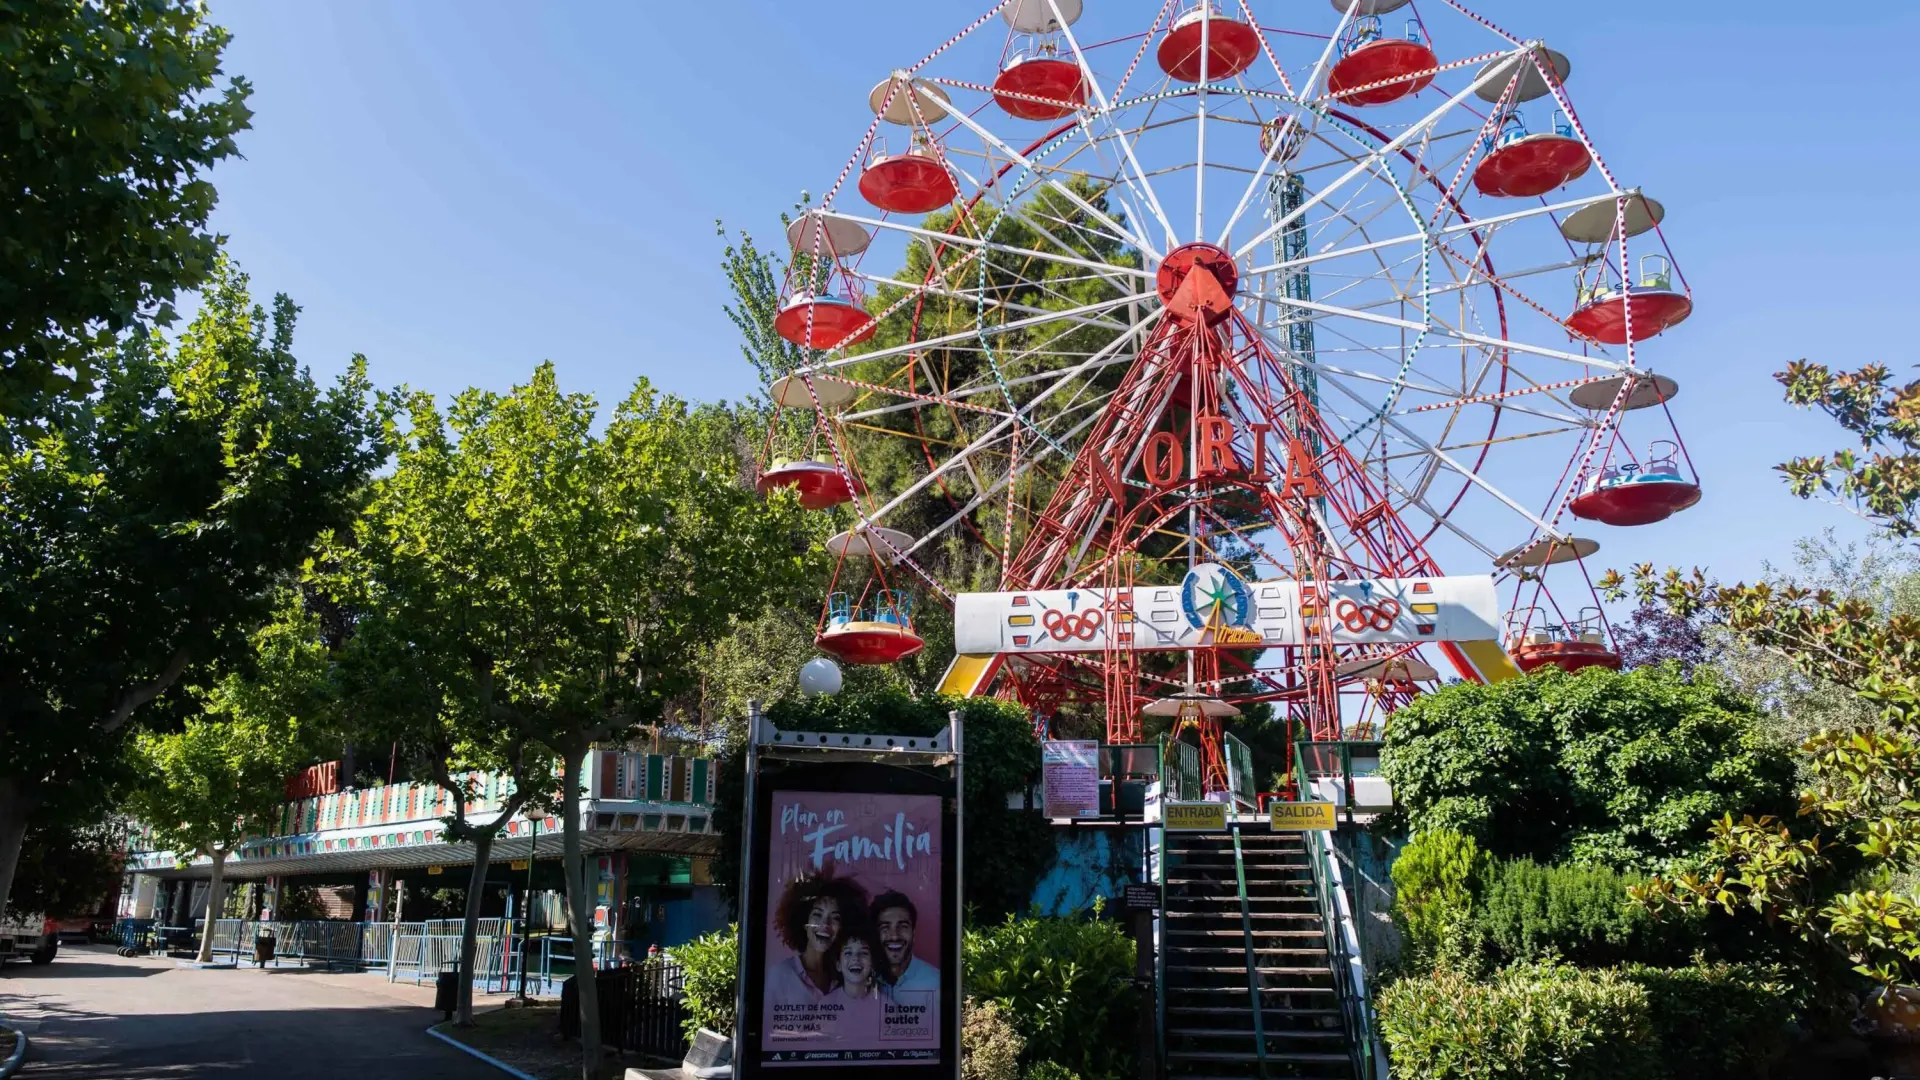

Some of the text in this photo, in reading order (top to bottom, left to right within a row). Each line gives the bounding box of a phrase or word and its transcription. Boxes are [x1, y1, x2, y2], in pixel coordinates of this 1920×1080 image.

[1086, 416, 1322, 506] NORIA
[1199, 598, 1263, 644] Atracciones
[1167, 806, 1220, 818] ENTRADA
[1275, 806, 1324, 818] SALIDA
[781, 803, 845, 835] plan en
[803, 812, 931, 872] Familia
[773, 1003, 845, 1013] OUTLET DE MODA
[884, 1004, 926, 1013] la torre
[773, 1014, 838, 1022] RESTAURANTES
[884, 1014, 920, 1025] outlet
[884, 1025, 929, 1037] Zaragoza
